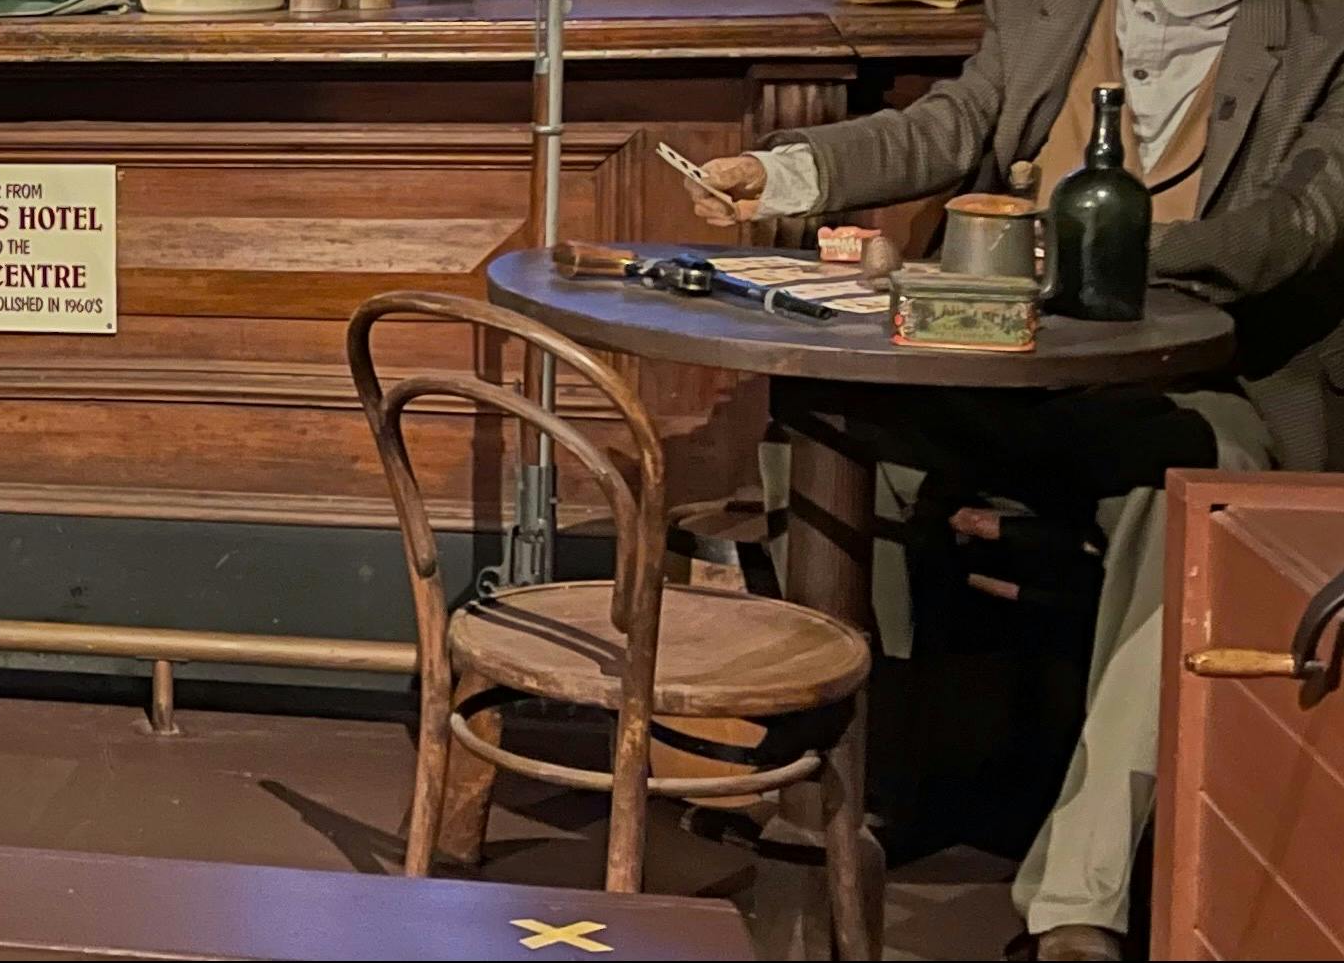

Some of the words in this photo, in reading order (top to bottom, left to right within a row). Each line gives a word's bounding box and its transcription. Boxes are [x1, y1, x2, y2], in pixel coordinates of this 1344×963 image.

[6, 184, 43, 199] FROM
[18, 206, 103, 231] HOTEL
[7, 239, 31, 255] THE
[48, 297, 60, 313] IN
[64, 298, 103, 314] 1960'S
